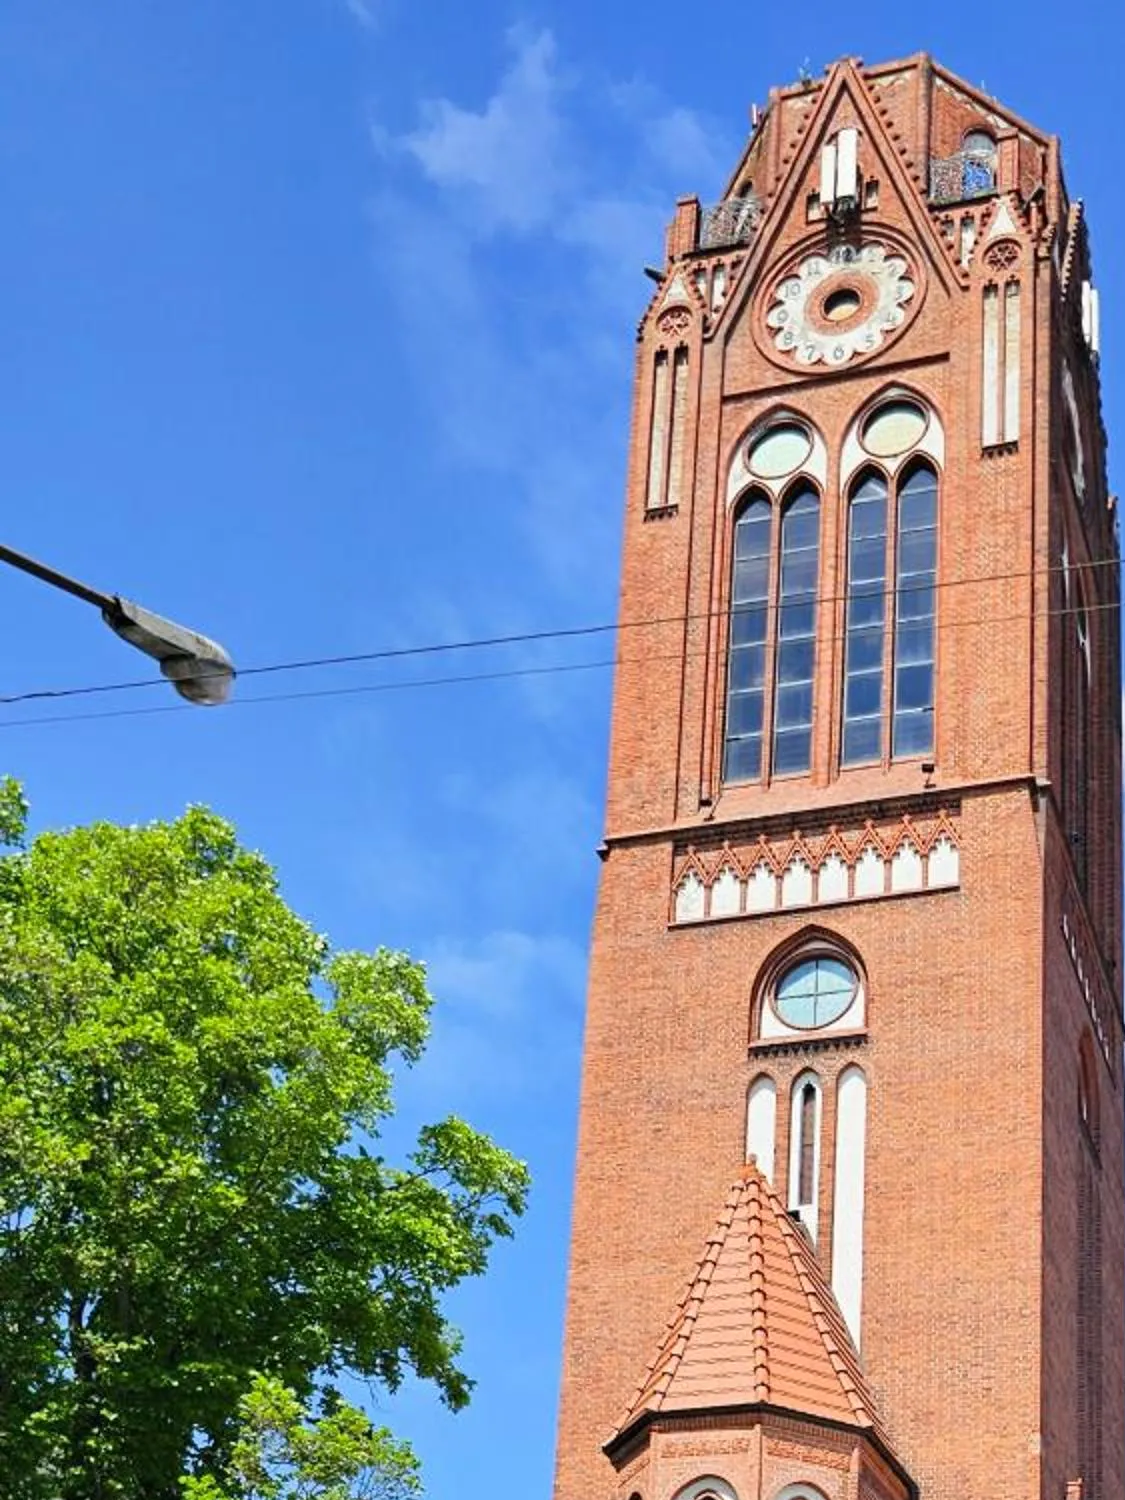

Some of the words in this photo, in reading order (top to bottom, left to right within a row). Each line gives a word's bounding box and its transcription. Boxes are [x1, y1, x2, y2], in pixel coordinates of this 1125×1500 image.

[807, 261, 821, 276] 11
[784, 283, 800, 298] 10
[784, 331, 794, 345] 8
[805, 344, 816, 360] 7
